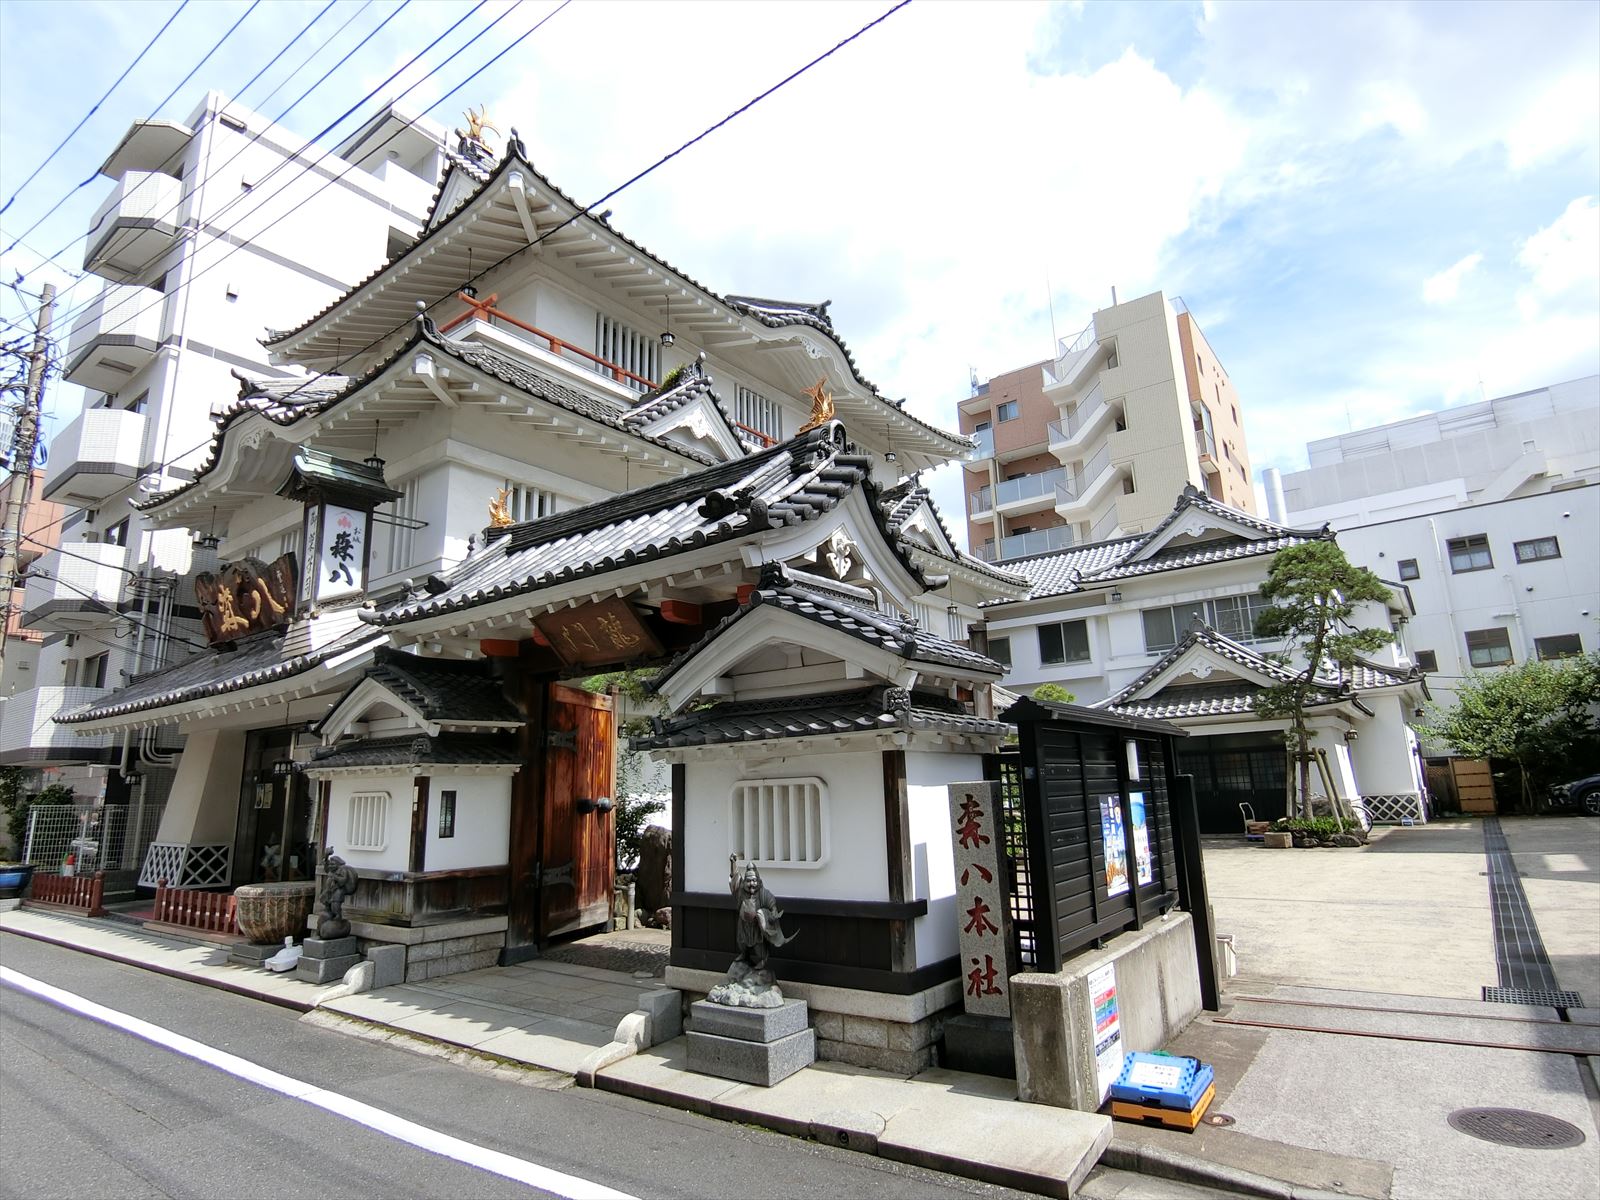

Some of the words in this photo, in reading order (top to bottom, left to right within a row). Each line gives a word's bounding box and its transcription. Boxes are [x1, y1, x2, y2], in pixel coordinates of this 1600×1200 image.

[328, 530, 354, 587] 森八
[956, 793, 1003, 999] 森八本社
